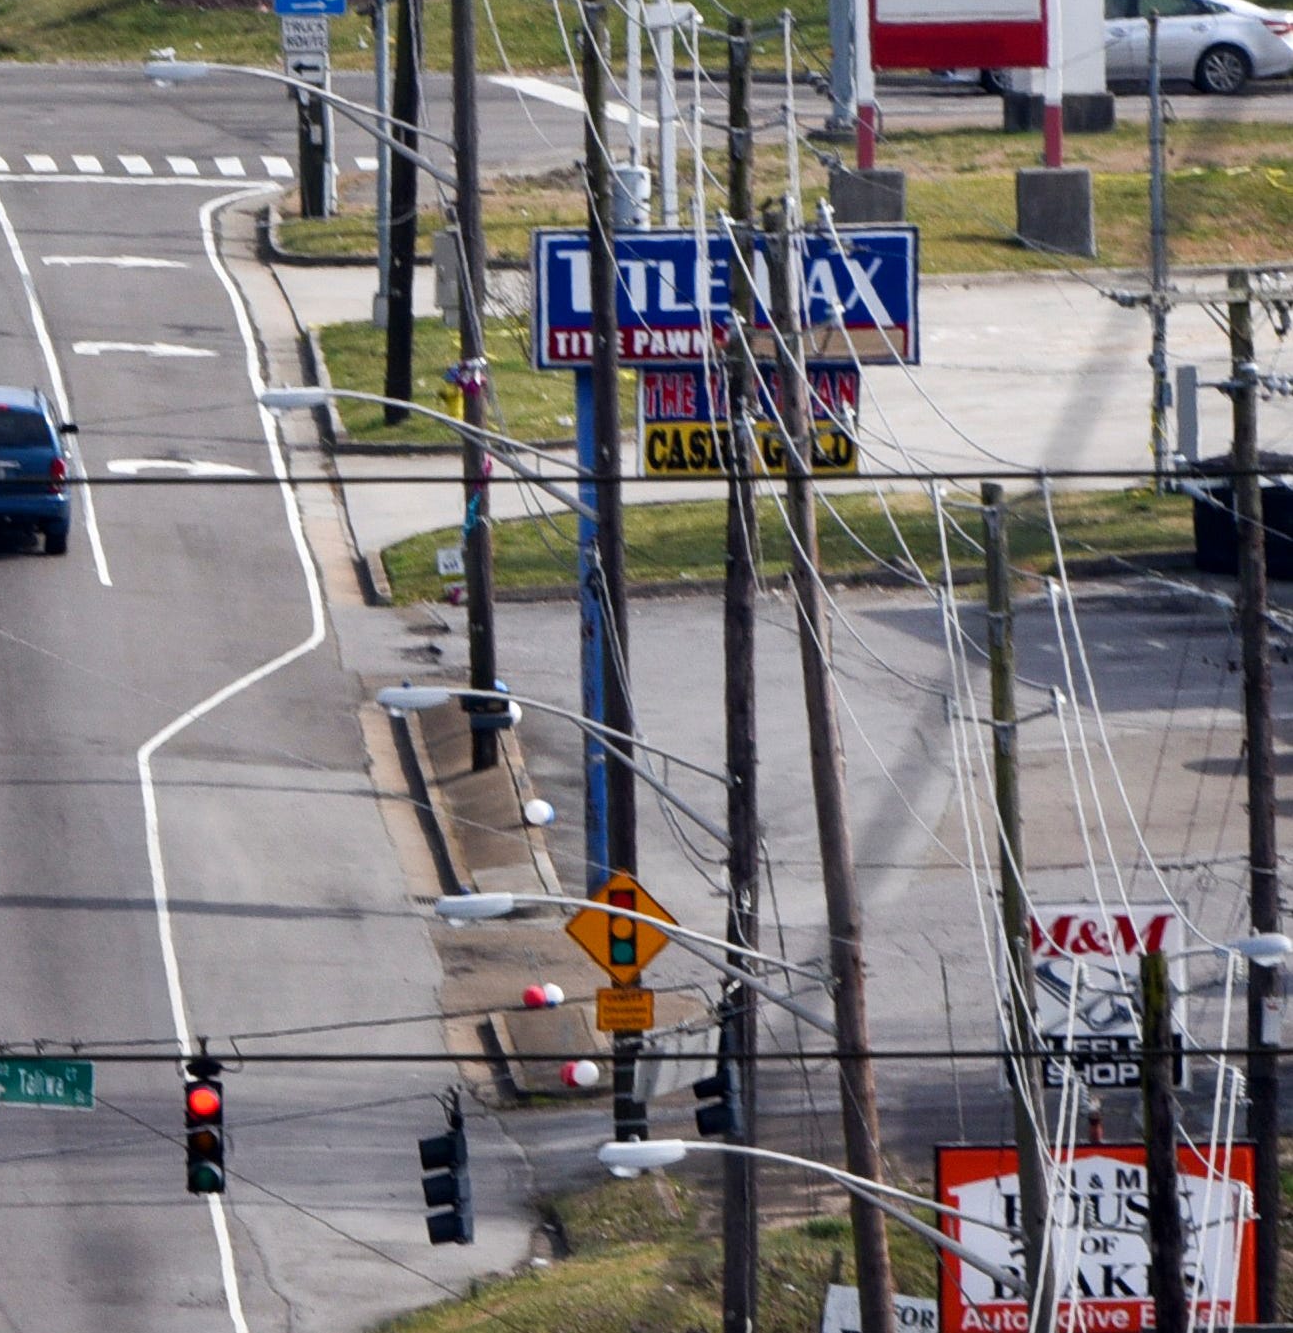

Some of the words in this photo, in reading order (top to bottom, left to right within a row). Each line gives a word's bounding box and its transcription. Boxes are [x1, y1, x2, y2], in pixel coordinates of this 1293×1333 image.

[645, 373, 697, 417] THE
[1046, 1063, 1141, 1086] SHOP
[1116, 1169, 1142, 1189] M
[1079, 1235, 1119, 1256] OF
